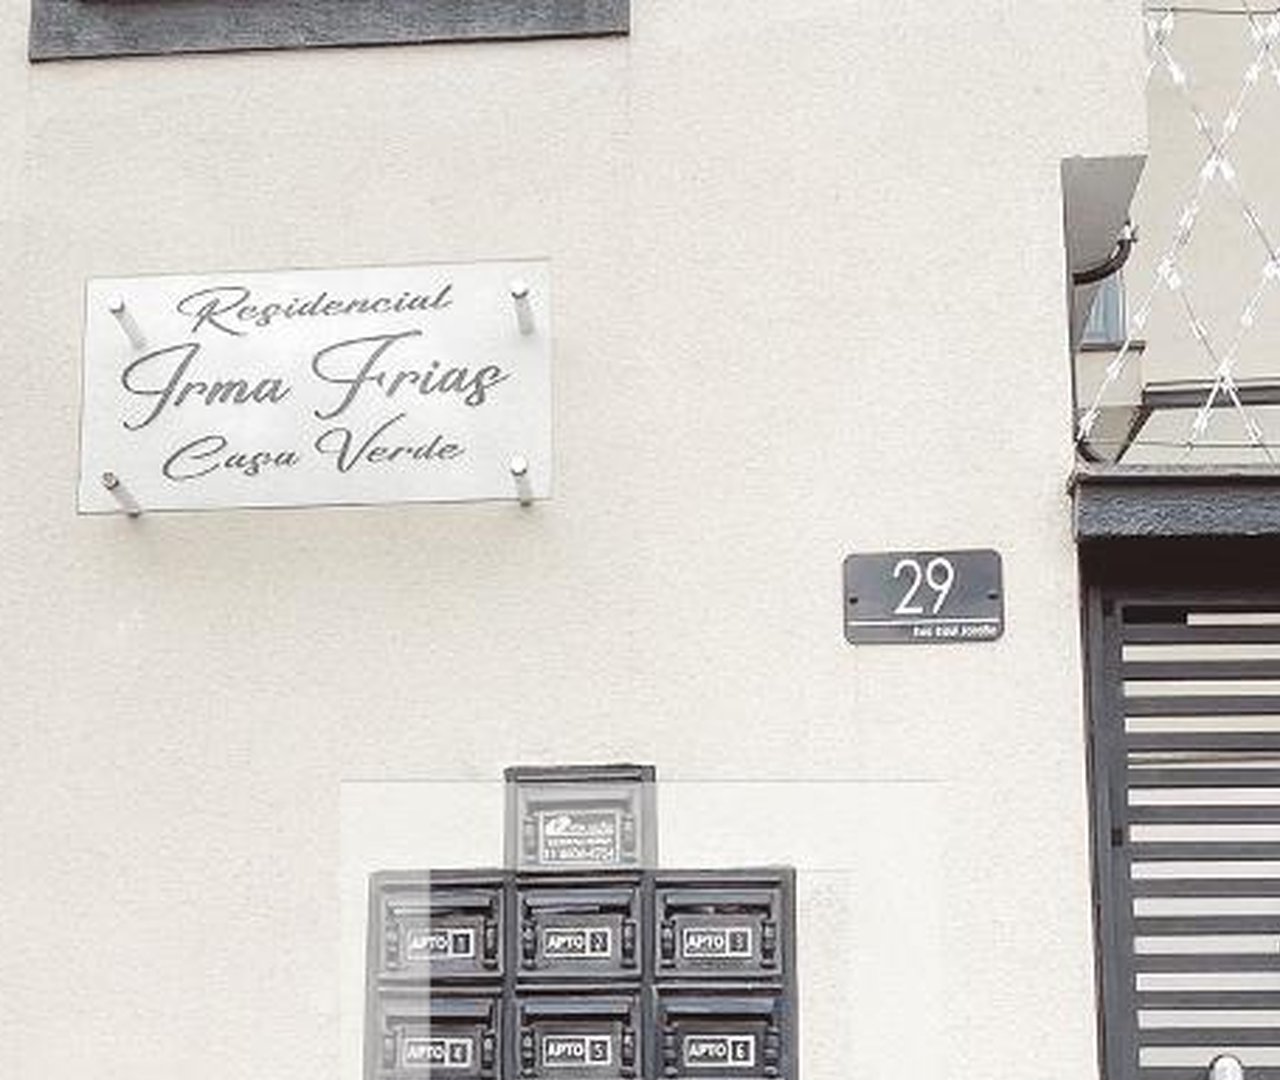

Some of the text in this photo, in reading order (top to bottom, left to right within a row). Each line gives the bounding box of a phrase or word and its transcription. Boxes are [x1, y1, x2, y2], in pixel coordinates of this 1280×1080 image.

[177, 284, 452, 336] Residencial
[121, 329, 511, 431] Irma Frias
[162, 412, 466, 482] Casa Verde
[893, 557, 955, 615] 29
[409, 935, 447, 950] APTO
[547, 935, 584, 950] APTO
[688, 935, 724, 951] APTO
[407, 1045, 444, 1059] APTO
[547, 1043, 584, 1057] APTO
[689, 1043, 727, 1057] APTO
